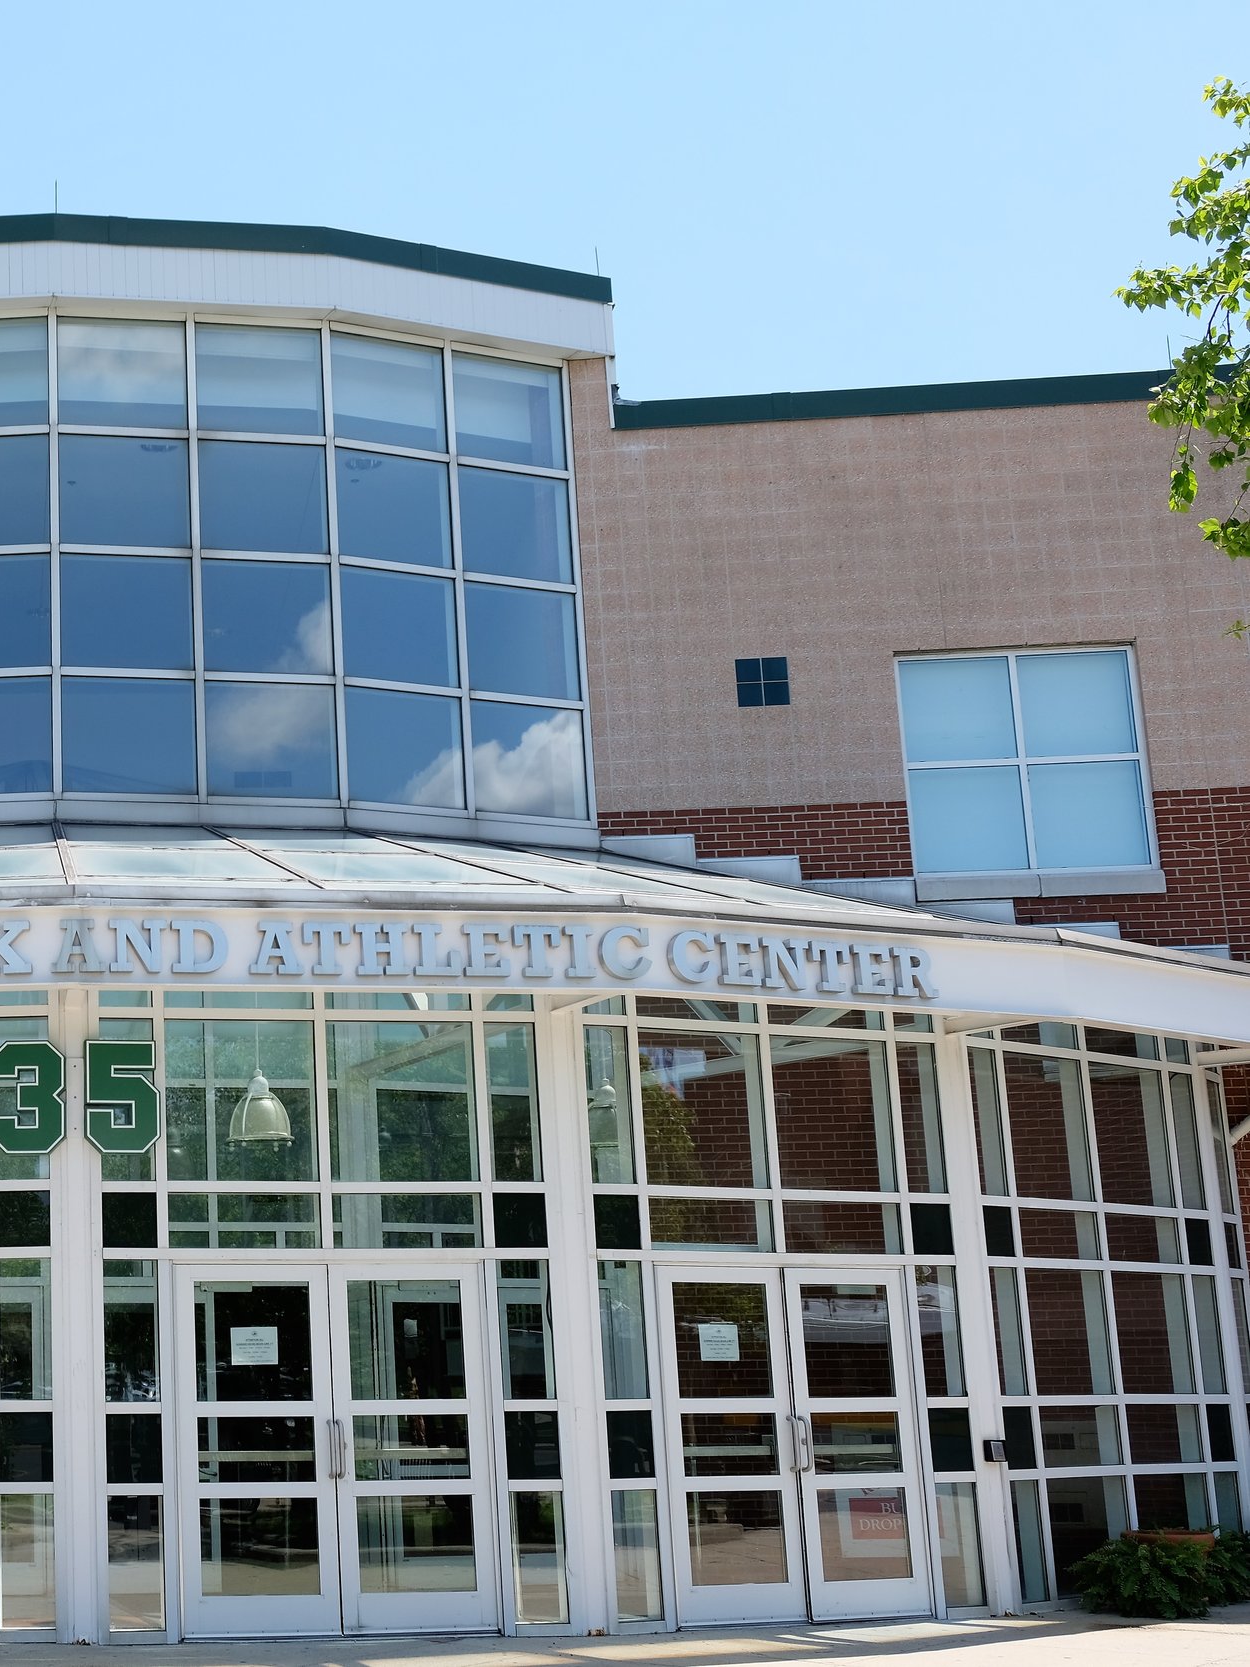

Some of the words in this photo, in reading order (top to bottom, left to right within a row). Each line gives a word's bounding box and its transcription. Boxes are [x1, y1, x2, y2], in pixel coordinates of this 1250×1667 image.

[51, 918, 228, 974] AND
[249, 921, 653, 980] ATHLETIC
[667, 930, 938, 999] CENTER
